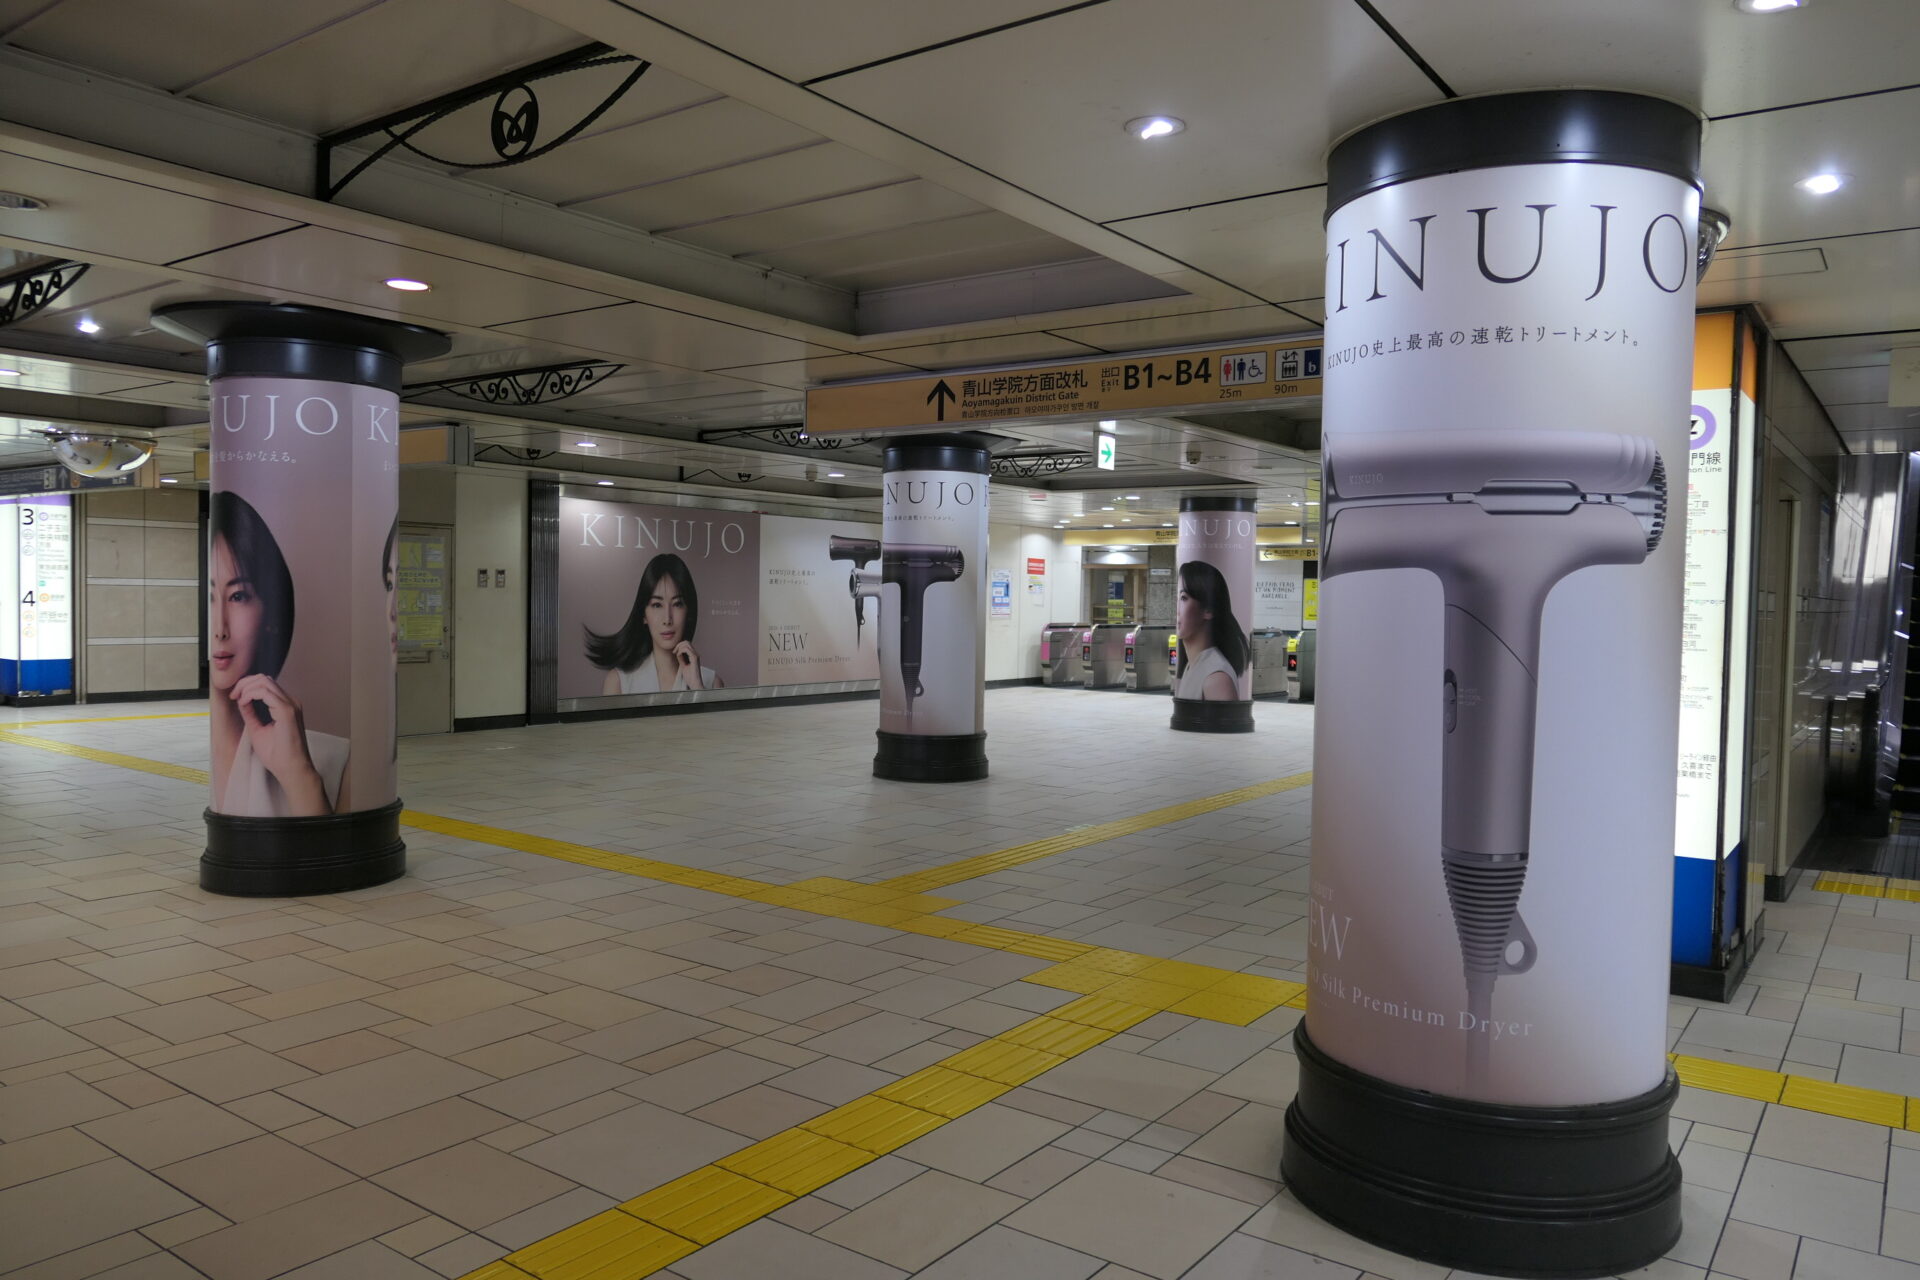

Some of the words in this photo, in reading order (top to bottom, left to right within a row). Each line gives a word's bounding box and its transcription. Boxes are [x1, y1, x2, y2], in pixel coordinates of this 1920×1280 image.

[1324, 204, 1688, 320] INUJO
[1327, 325, 1639, 370] KINUJO史上最高の速乾トリートメント。
[1101, 366, 1120, 378] 出口
[962, 370, 1088, 397] 青山学院方面改札
[1101, 377, 1119, 388] Exit
[1274, 384, 1298, 394] 90m
[962, 395, 1023, 409] Aoyamagakuin
[1026, 391, 1056, 403] District
[1058, 390, 1079, 400] Gate
[1219, 388, 1242, 399] 25m
[210, 394, 338, 441] UJO
[1691, 452, 1721, 465] 門線
[22, 508, 35, 525] 3
[580, 512, 745, 558] KINUJO
[22, 591, 36, 606] 4
[768, 632, 808, 652] NEW
[1322, 973, 1345, 999] Silk
[1352, 986, 1445, 1027] Premium
[1458, 1011, 1533, 1041] Dryer
